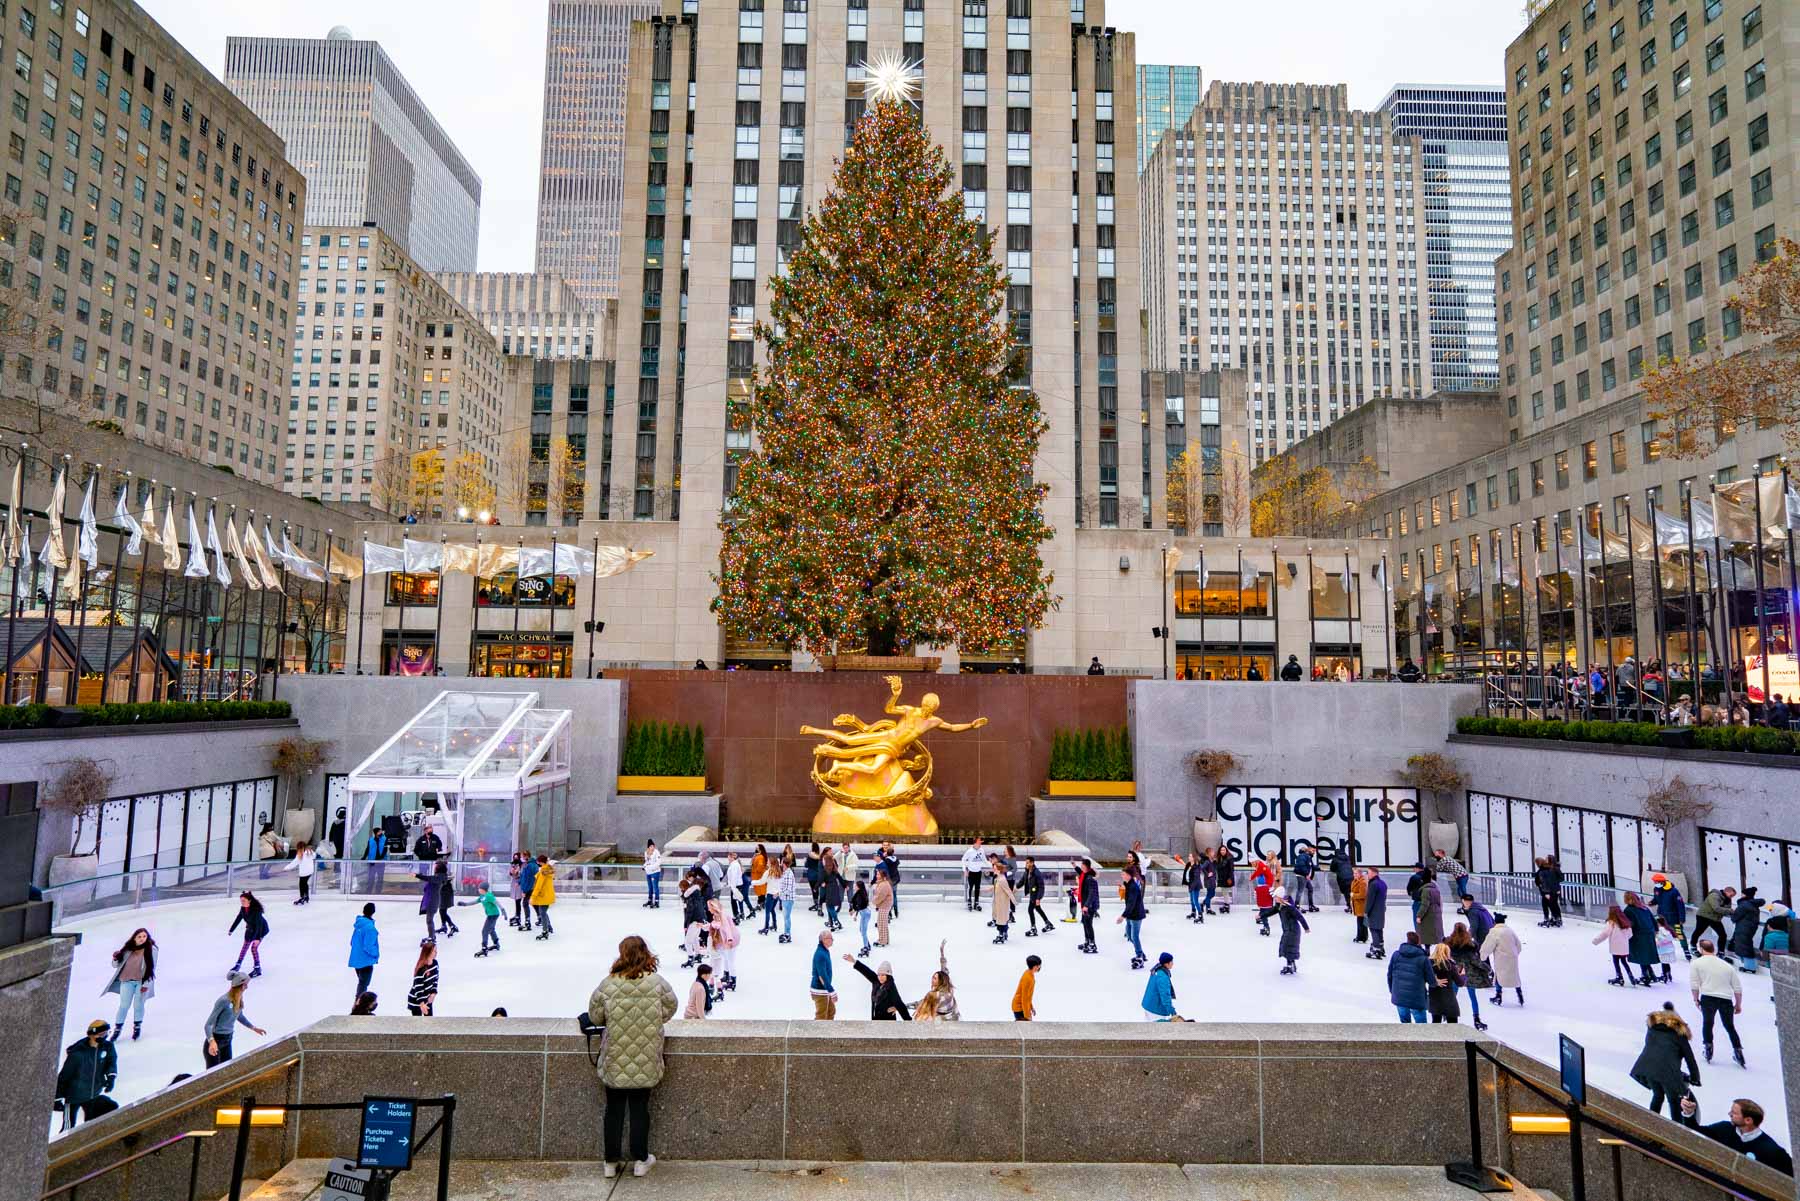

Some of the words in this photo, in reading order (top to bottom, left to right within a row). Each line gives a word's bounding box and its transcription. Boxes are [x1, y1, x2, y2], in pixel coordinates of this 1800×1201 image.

[519, 580, 545, 592] SING
[527, 589, 536, 598] 2
[519, 633, 555, 641] SCHWAR
[403, 648, 423, 658] SING
[1216, 787, 1419, 822] Concourse
[1222, 829, 1243, 862] s
[1254, 828, 1362, 865] Open
[330, 1174, 364, 1194] CAUTION
